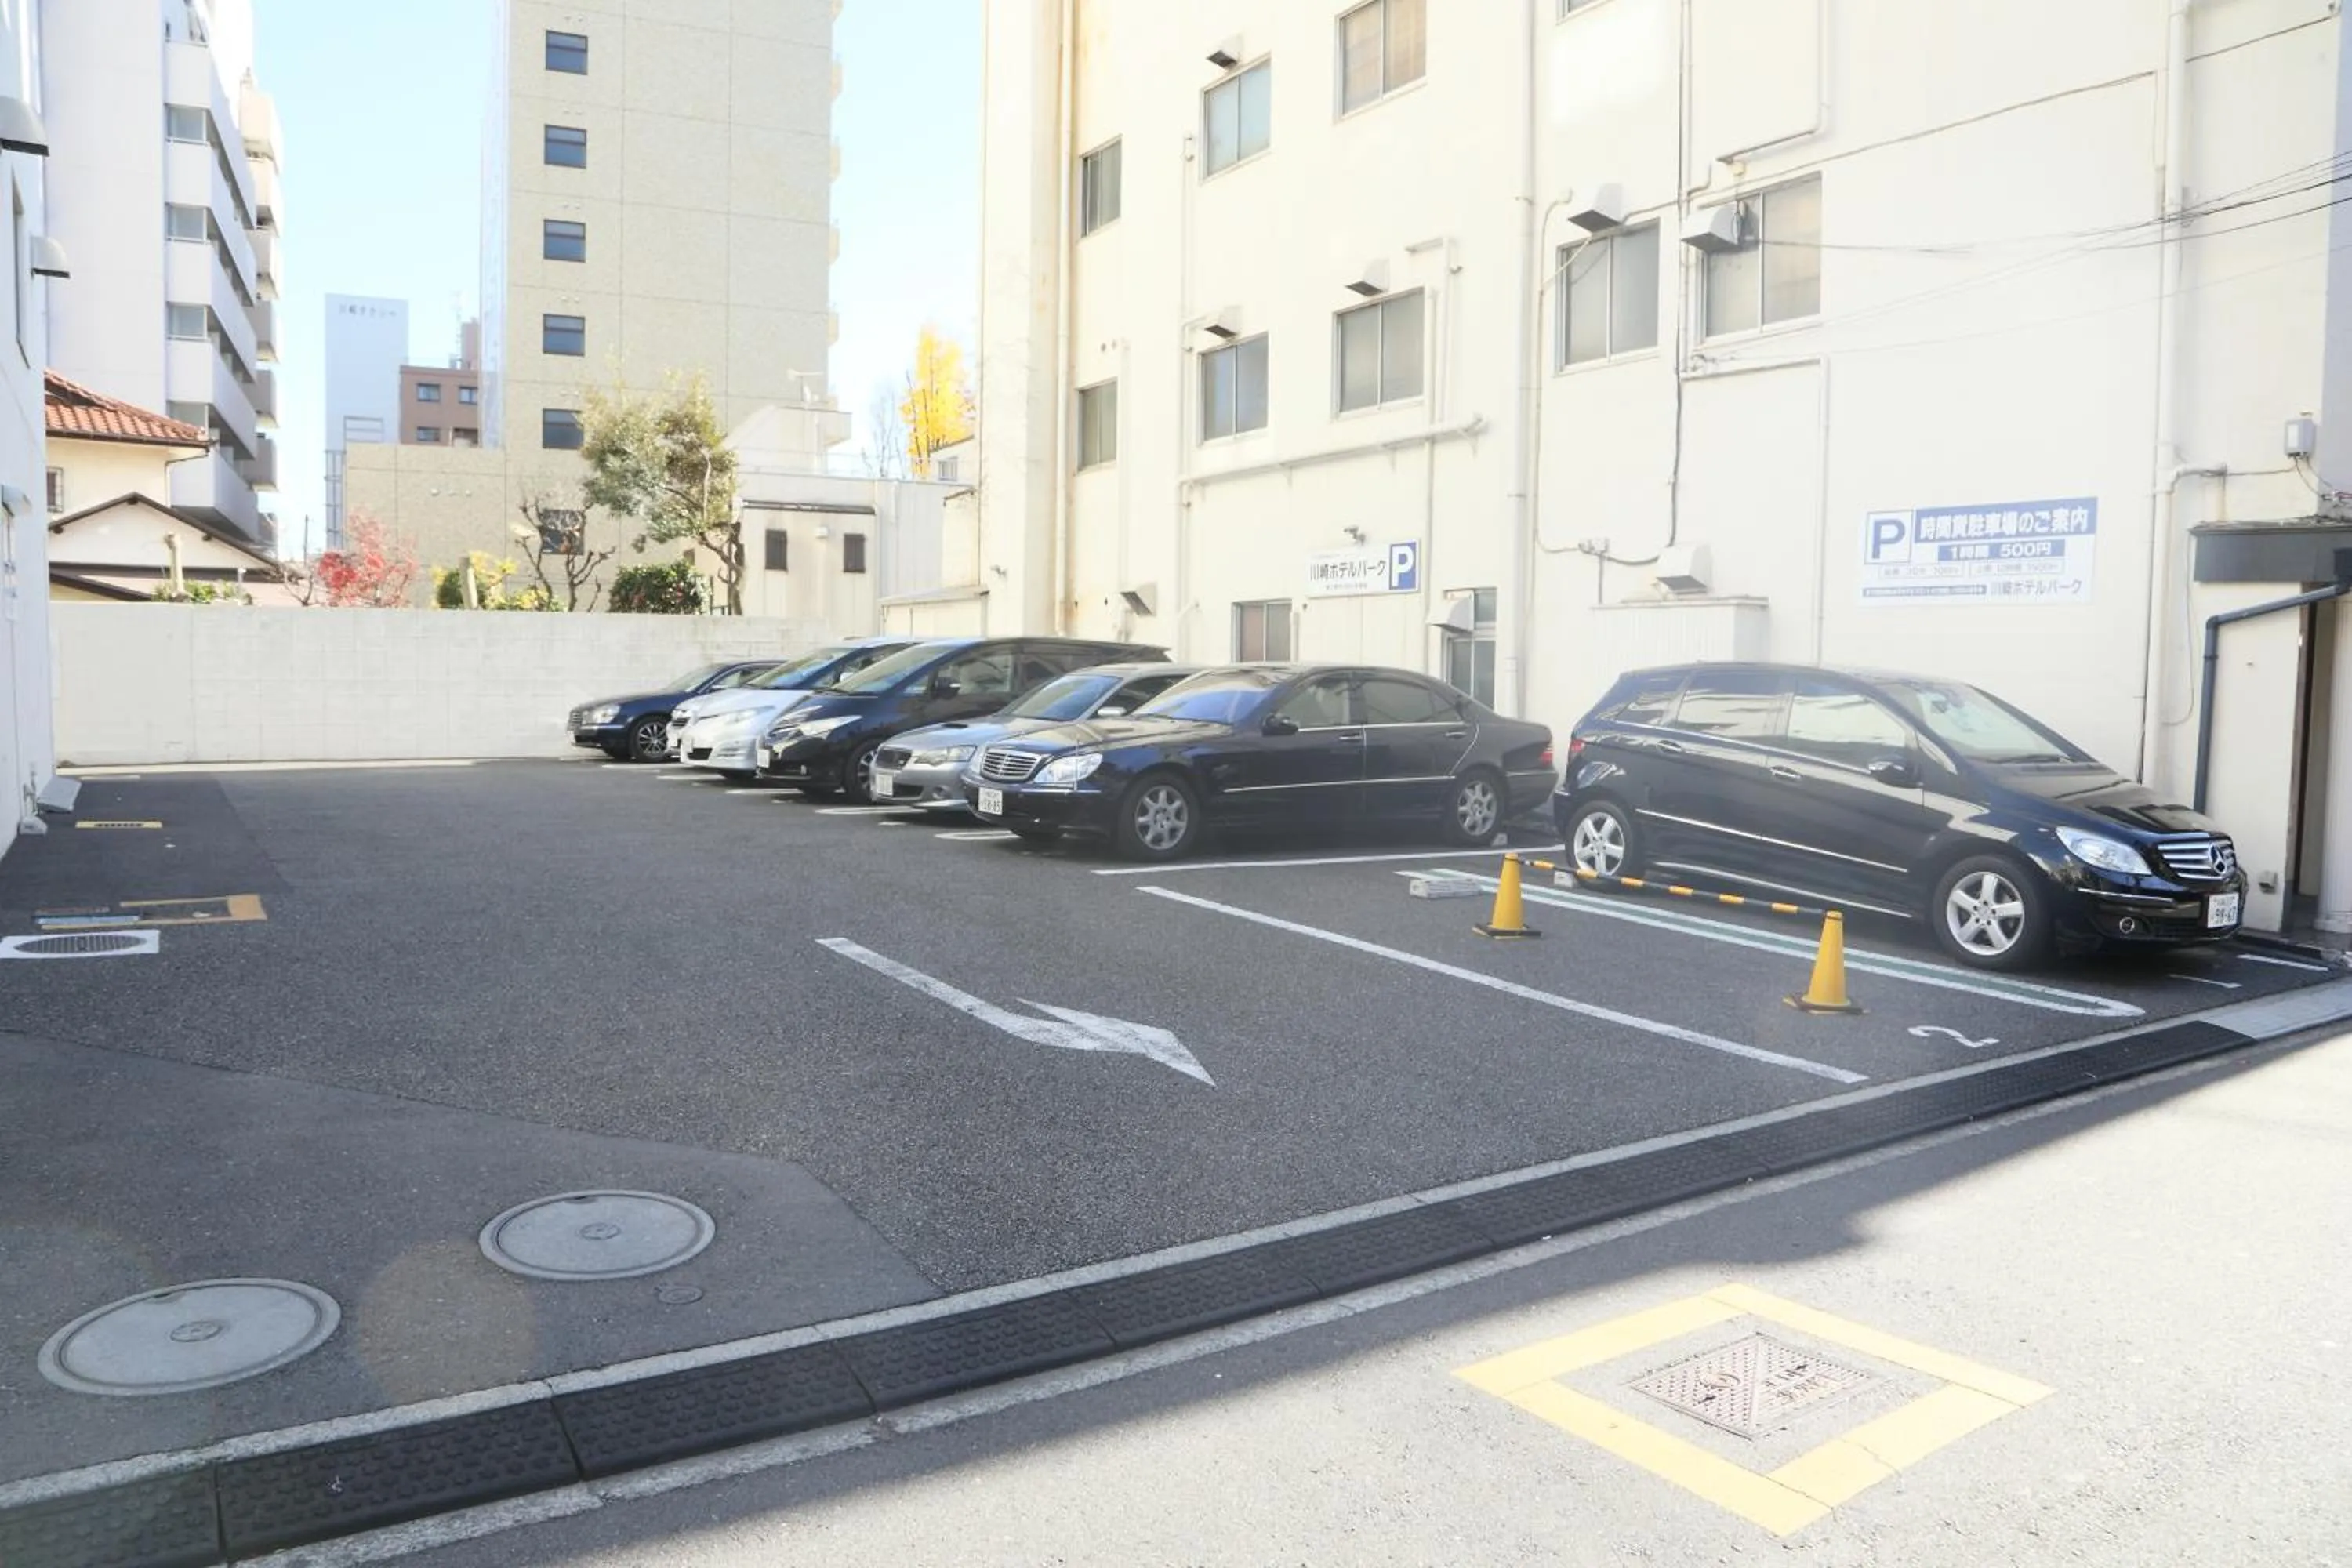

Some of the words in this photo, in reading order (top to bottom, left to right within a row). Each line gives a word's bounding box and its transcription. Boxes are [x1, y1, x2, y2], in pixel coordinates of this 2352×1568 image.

[1871, 518, 1906, 559] P
[1950, 545, 1990, 560] 1時間
[2000, 541, 2052, 557] 500円
[1392, 545, 1414, 587] P
[1907, 1025, 2000, 1048] 2
